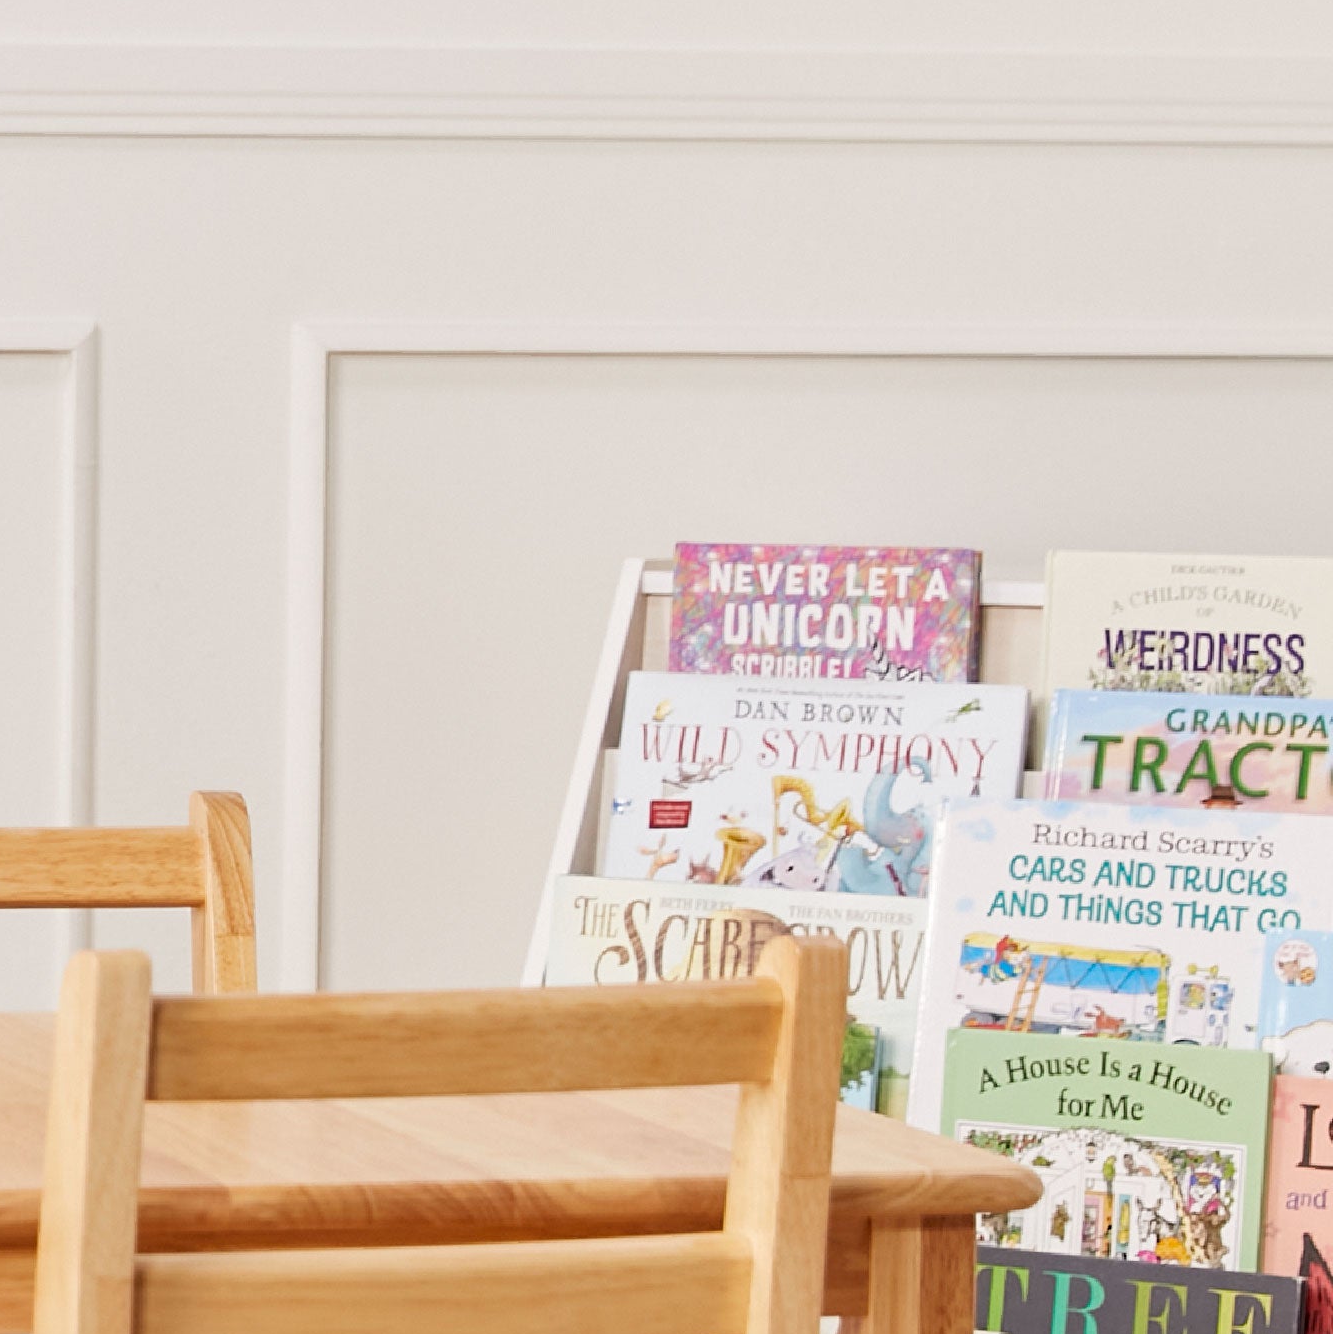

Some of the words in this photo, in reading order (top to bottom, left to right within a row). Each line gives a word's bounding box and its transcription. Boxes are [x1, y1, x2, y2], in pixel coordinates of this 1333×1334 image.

[709, 561, 831, 598] NEVER
[845, 563, 915, 599] LET
[923, 568, 949, 602] A
[1129, 585, 1208, 608] CHILD'S
[1213, 586, 1303, 620] GARDEN
[723, 601, 915, 651] UNICORN
[734, 699, 790, 720] DAN
[801, 702, 905, 727] BROWN
[640, 722, 743, 765] WILD
[757, 727, 998, 780] SYMPHONY
[1081, 734, 1333, 800] TRACT
[1032, 823, 1149, 852] Richard
[1157, 831, 1275, 862] Scarry's
[1008, 855, 1087, 883] CARS
[1094, 859, 1157, 889] AND
[1165, 864, 1288, 898] TRUCKS
[574, 895, 620, 939] THE
[987, 889, 1049, 918] AND
[1172, 900, 1249, 933] THAT
[1256, 908, 1302, 933] GO
[979, 1068, 1000, 1094] A
[1005, 1053, 1090, 1084] House
[1099, 1051, 1122, 1078] Is
[1128, 1061, 1142, 1081] a
[1148, 1061, 1233, 1116] House
[1057, 1087, 1100, 1118] for
[1101, 1093, 1145, 1121] Me
[1296, 1103, 1333, 1170] L
[1286, 1189, 1327, 1211] and
